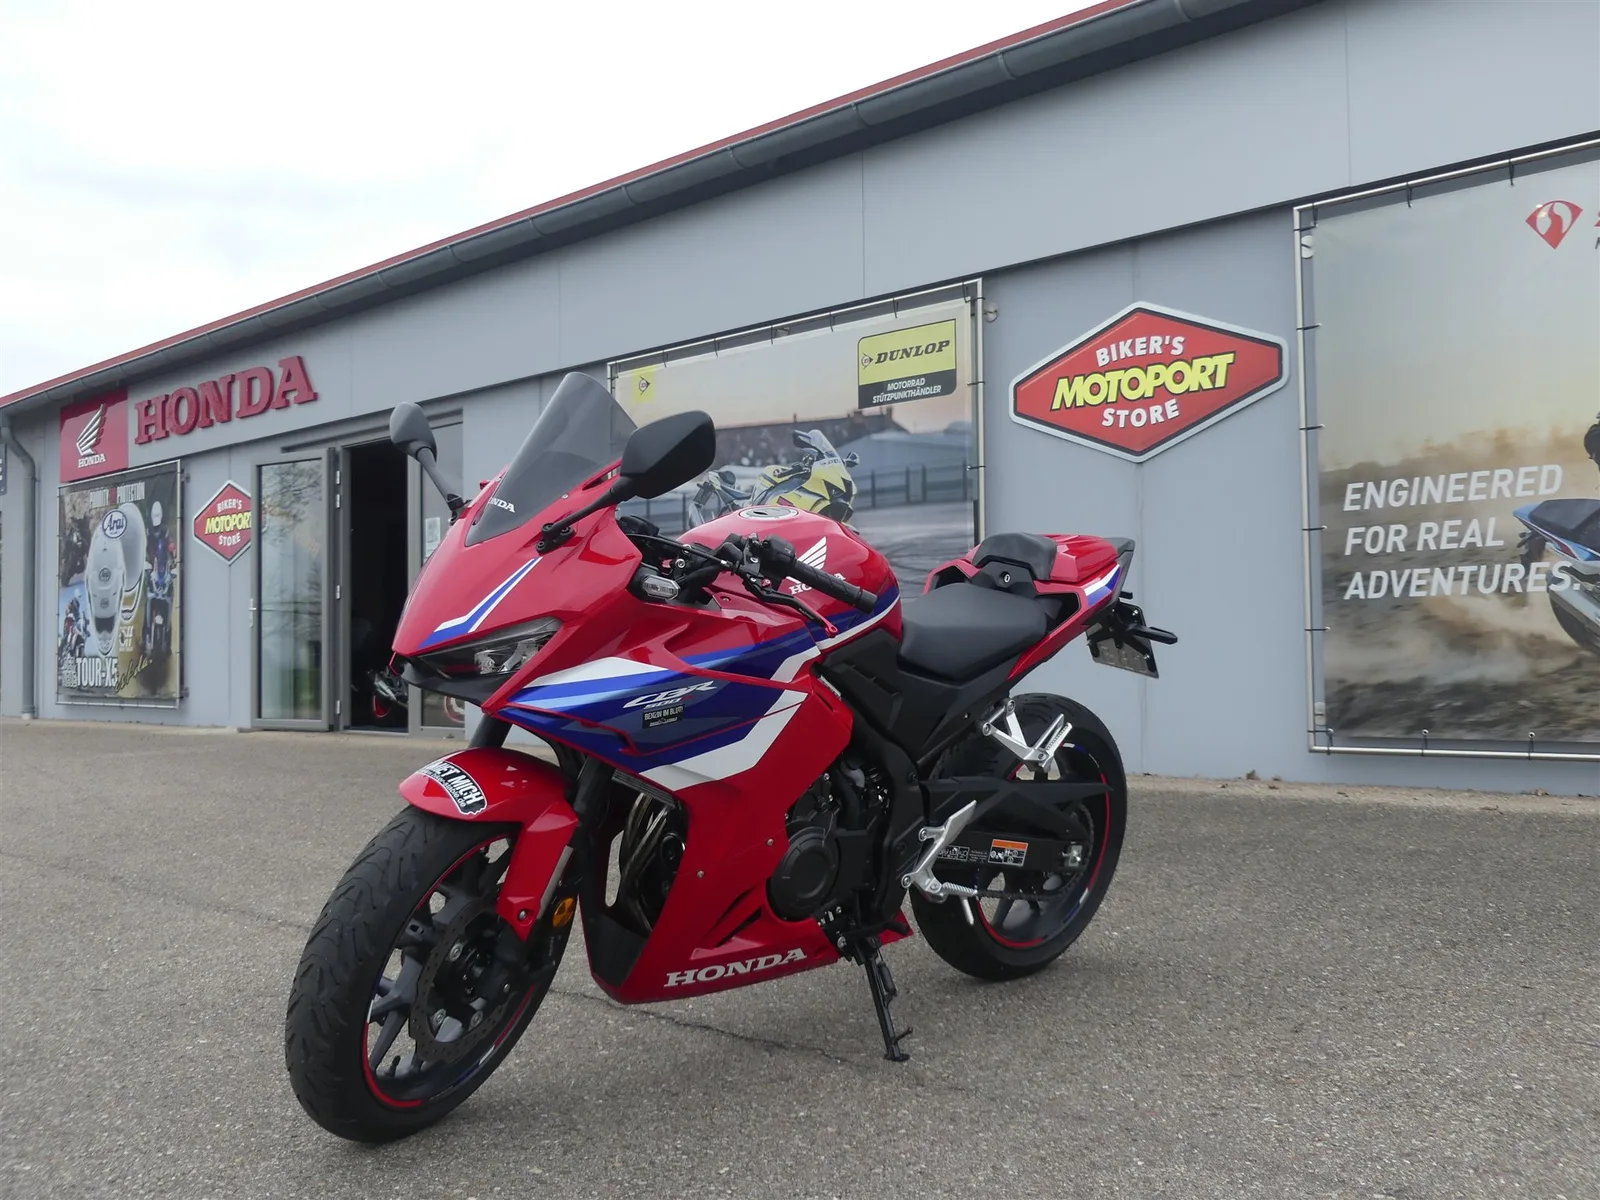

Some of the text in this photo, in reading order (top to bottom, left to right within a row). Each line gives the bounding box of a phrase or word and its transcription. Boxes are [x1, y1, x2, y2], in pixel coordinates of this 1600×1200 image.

[875, 340, 950, 365] DUNLOP
[1096, 335, 1186, 367] BIKER'S
[887, 378, 926, 392] MOTORRAD
[1051, 352, 1235, 411] MOTOPORT
[134, 355, 319, 445] HONDA
[1102, 398, 1180, 428] STORE
[77, 453, 106, 469] HONDA
[1343, 464, 1563, 512] ENGINEERED
[217, 498, 243, 513] BIKER'S
[488, 497, 516, 514] NDA
[218, 532, 241, 547] STORE
[1344, 517, 1505, 556] FOR REAL
[788, 572, 846, 595] HOA
[1343, 561, 1581, 600] ADVENTURES.
[76, 657, 118, 687] TOUR-X5
[623, 680, 718, 709] CBR
[664, 948, 807, 988] HONDA
